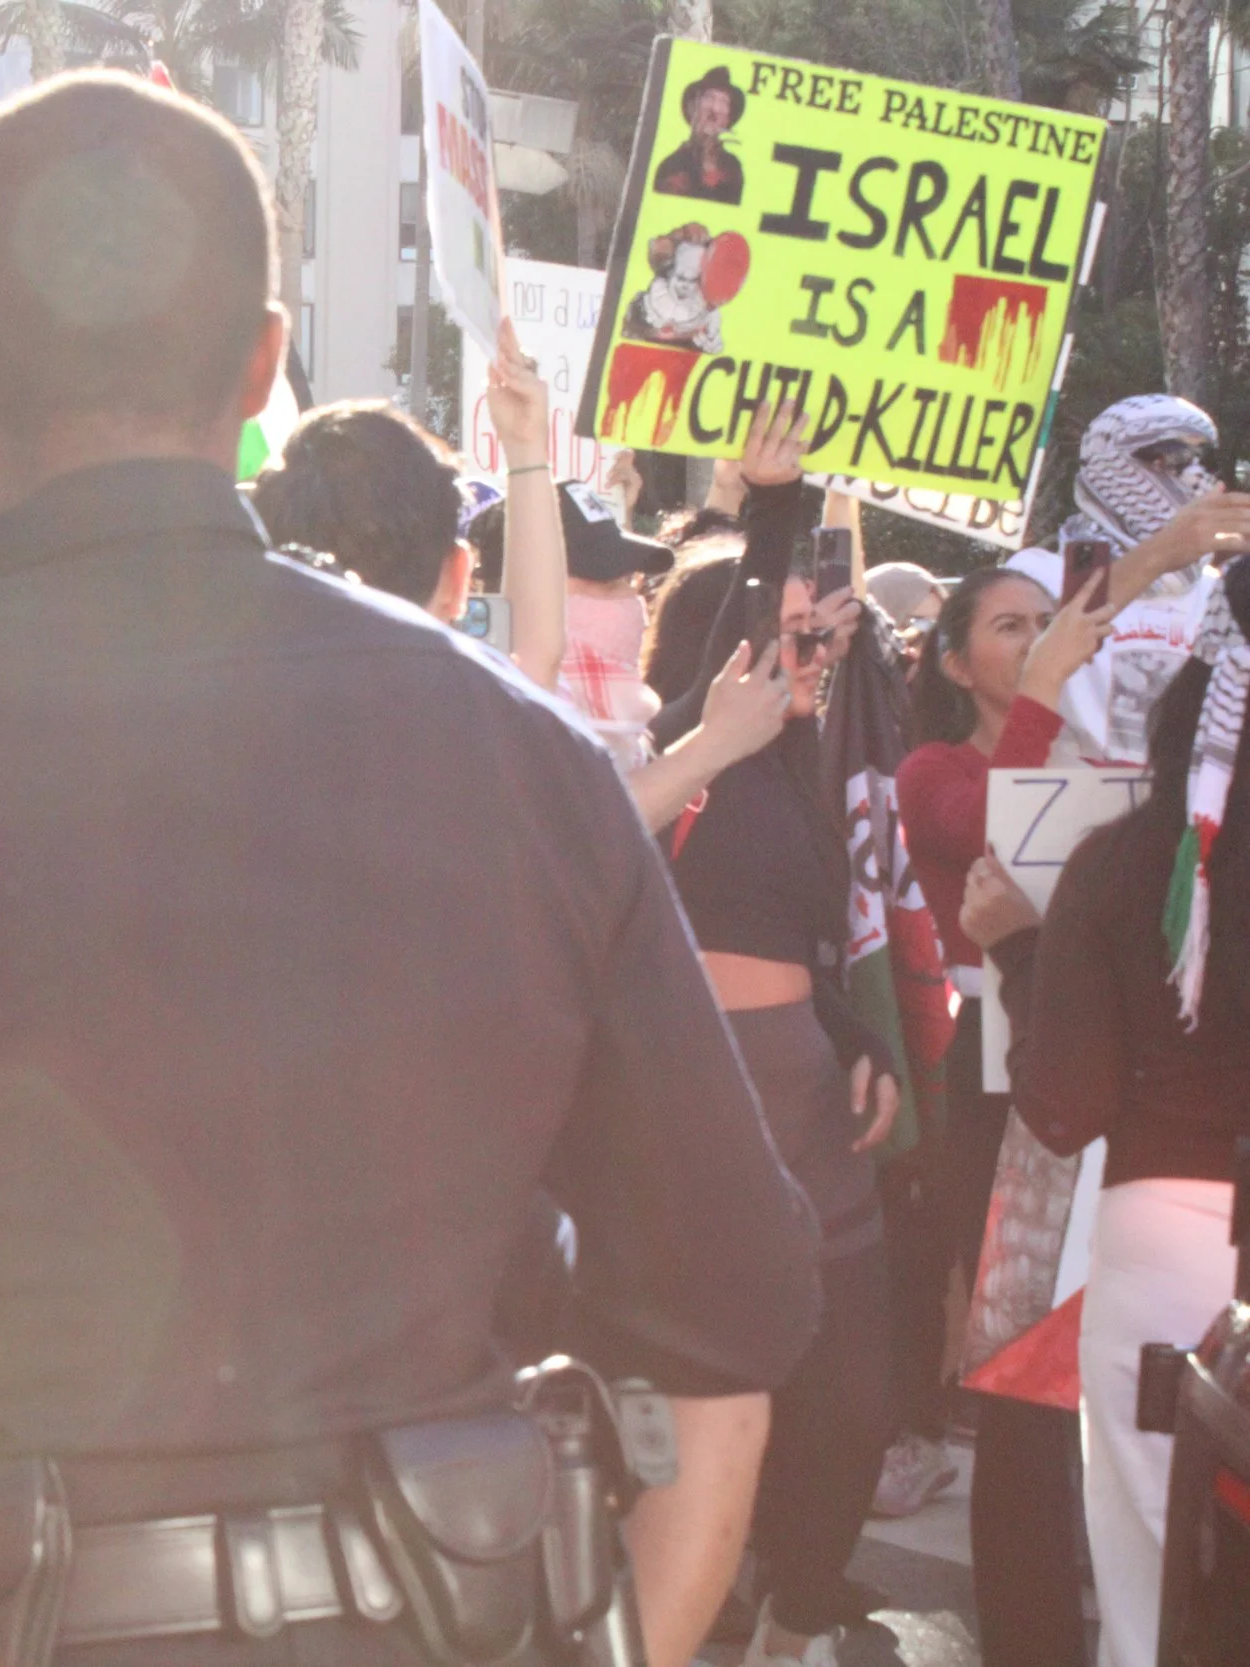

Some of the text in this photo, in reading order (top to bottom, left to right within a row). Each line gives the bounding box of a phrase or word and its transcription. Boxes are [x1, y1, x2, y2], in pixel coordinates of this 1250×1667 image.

[748, 61, 1097, 166] FREE PALESTINE
[758, 141, 1071, 283] ISRAEL
[789, 273, 927, 356] IS A
